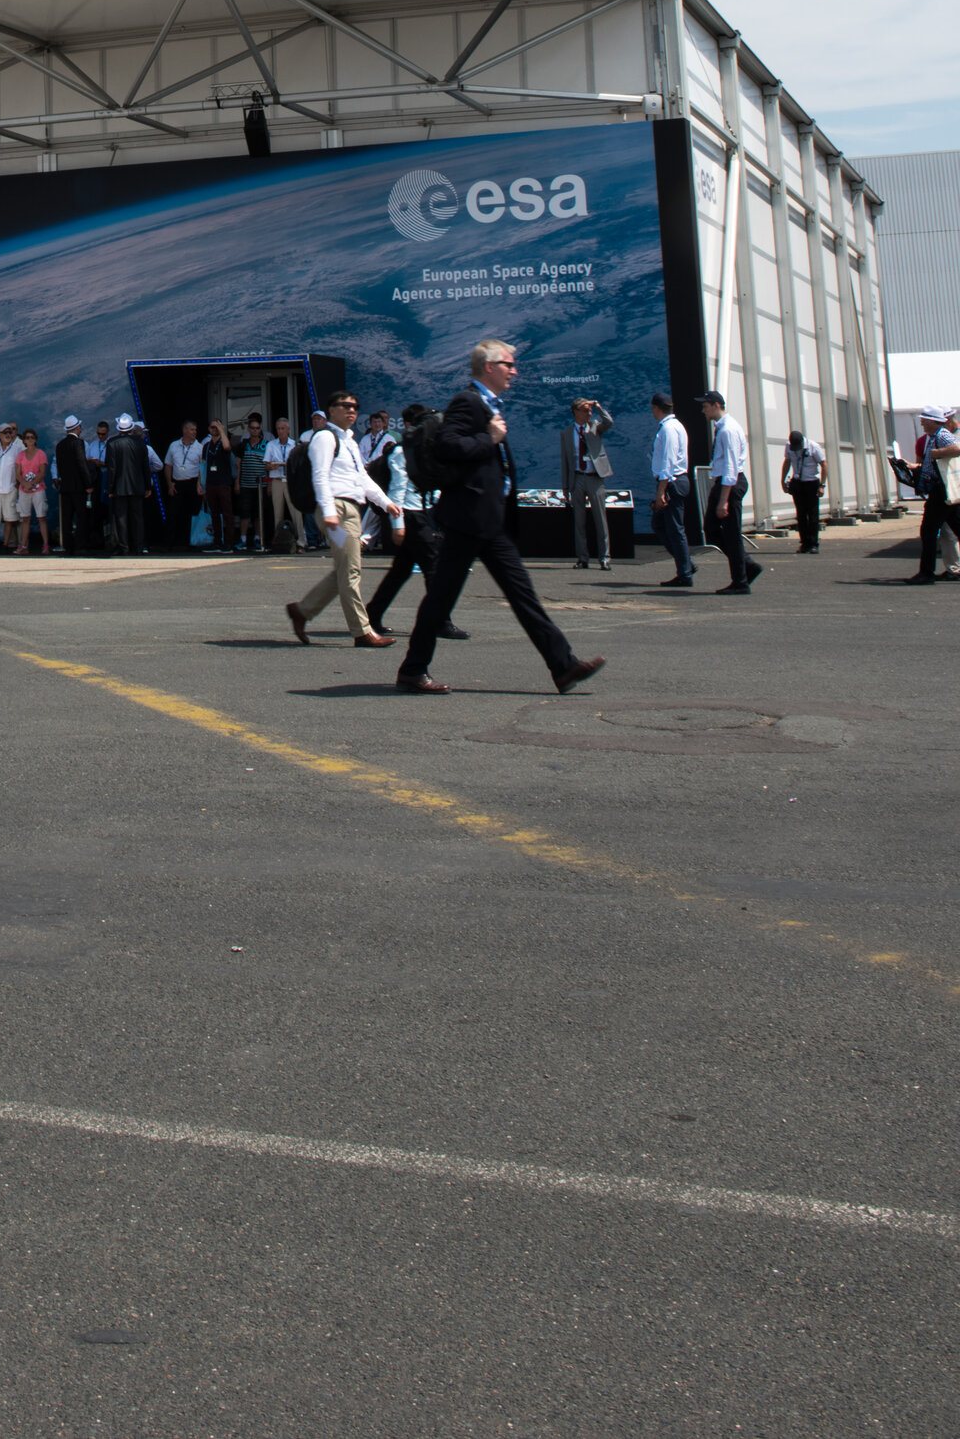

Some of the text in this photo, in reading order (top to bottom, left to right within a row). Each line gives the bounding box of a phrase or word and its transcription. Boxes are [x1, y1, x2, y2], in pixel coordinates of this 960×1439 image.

[465, 174, 589, 224] esa
[422, 262, 593, 283] European Space Agency
[392, 280, 595, 304] Agence spatiale européenne
